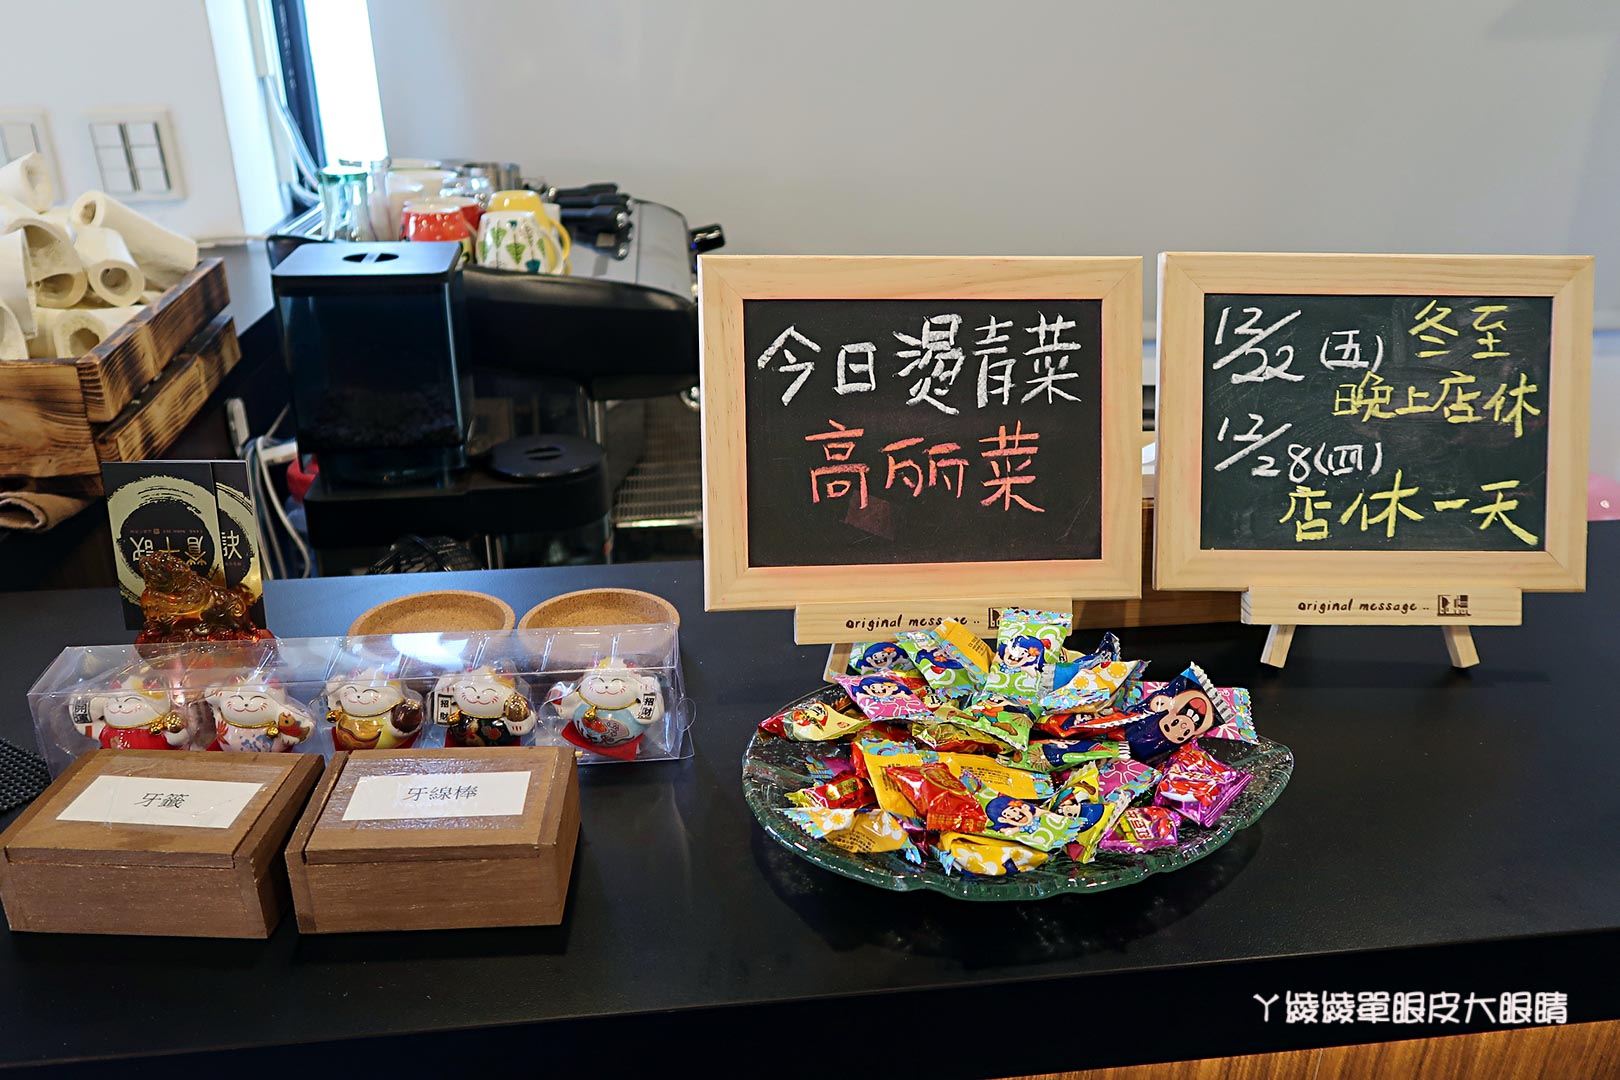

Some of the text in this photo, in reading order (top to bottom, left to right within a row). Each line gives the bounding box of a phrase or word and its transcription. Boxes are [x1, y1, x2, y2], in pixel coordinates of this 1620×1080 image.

[1213, 299, 1510, 385] 12/22 (五) 冬至
[756, 311, 1082, 416] 今日燙青菜
[1332, 370, 1541, 438] 晚上店休
[1279, 469, 1539, 546] 店休一天
[1297, 598, 1417, 615] original message
[845, 614, 968, 632] original messe
[438, 697, 450, 723] 招財
[640, 695, 656, 719] 招財
[134, 792, 189, 809] 牙籤
[402, 784, 478, 802] 牙線棒
